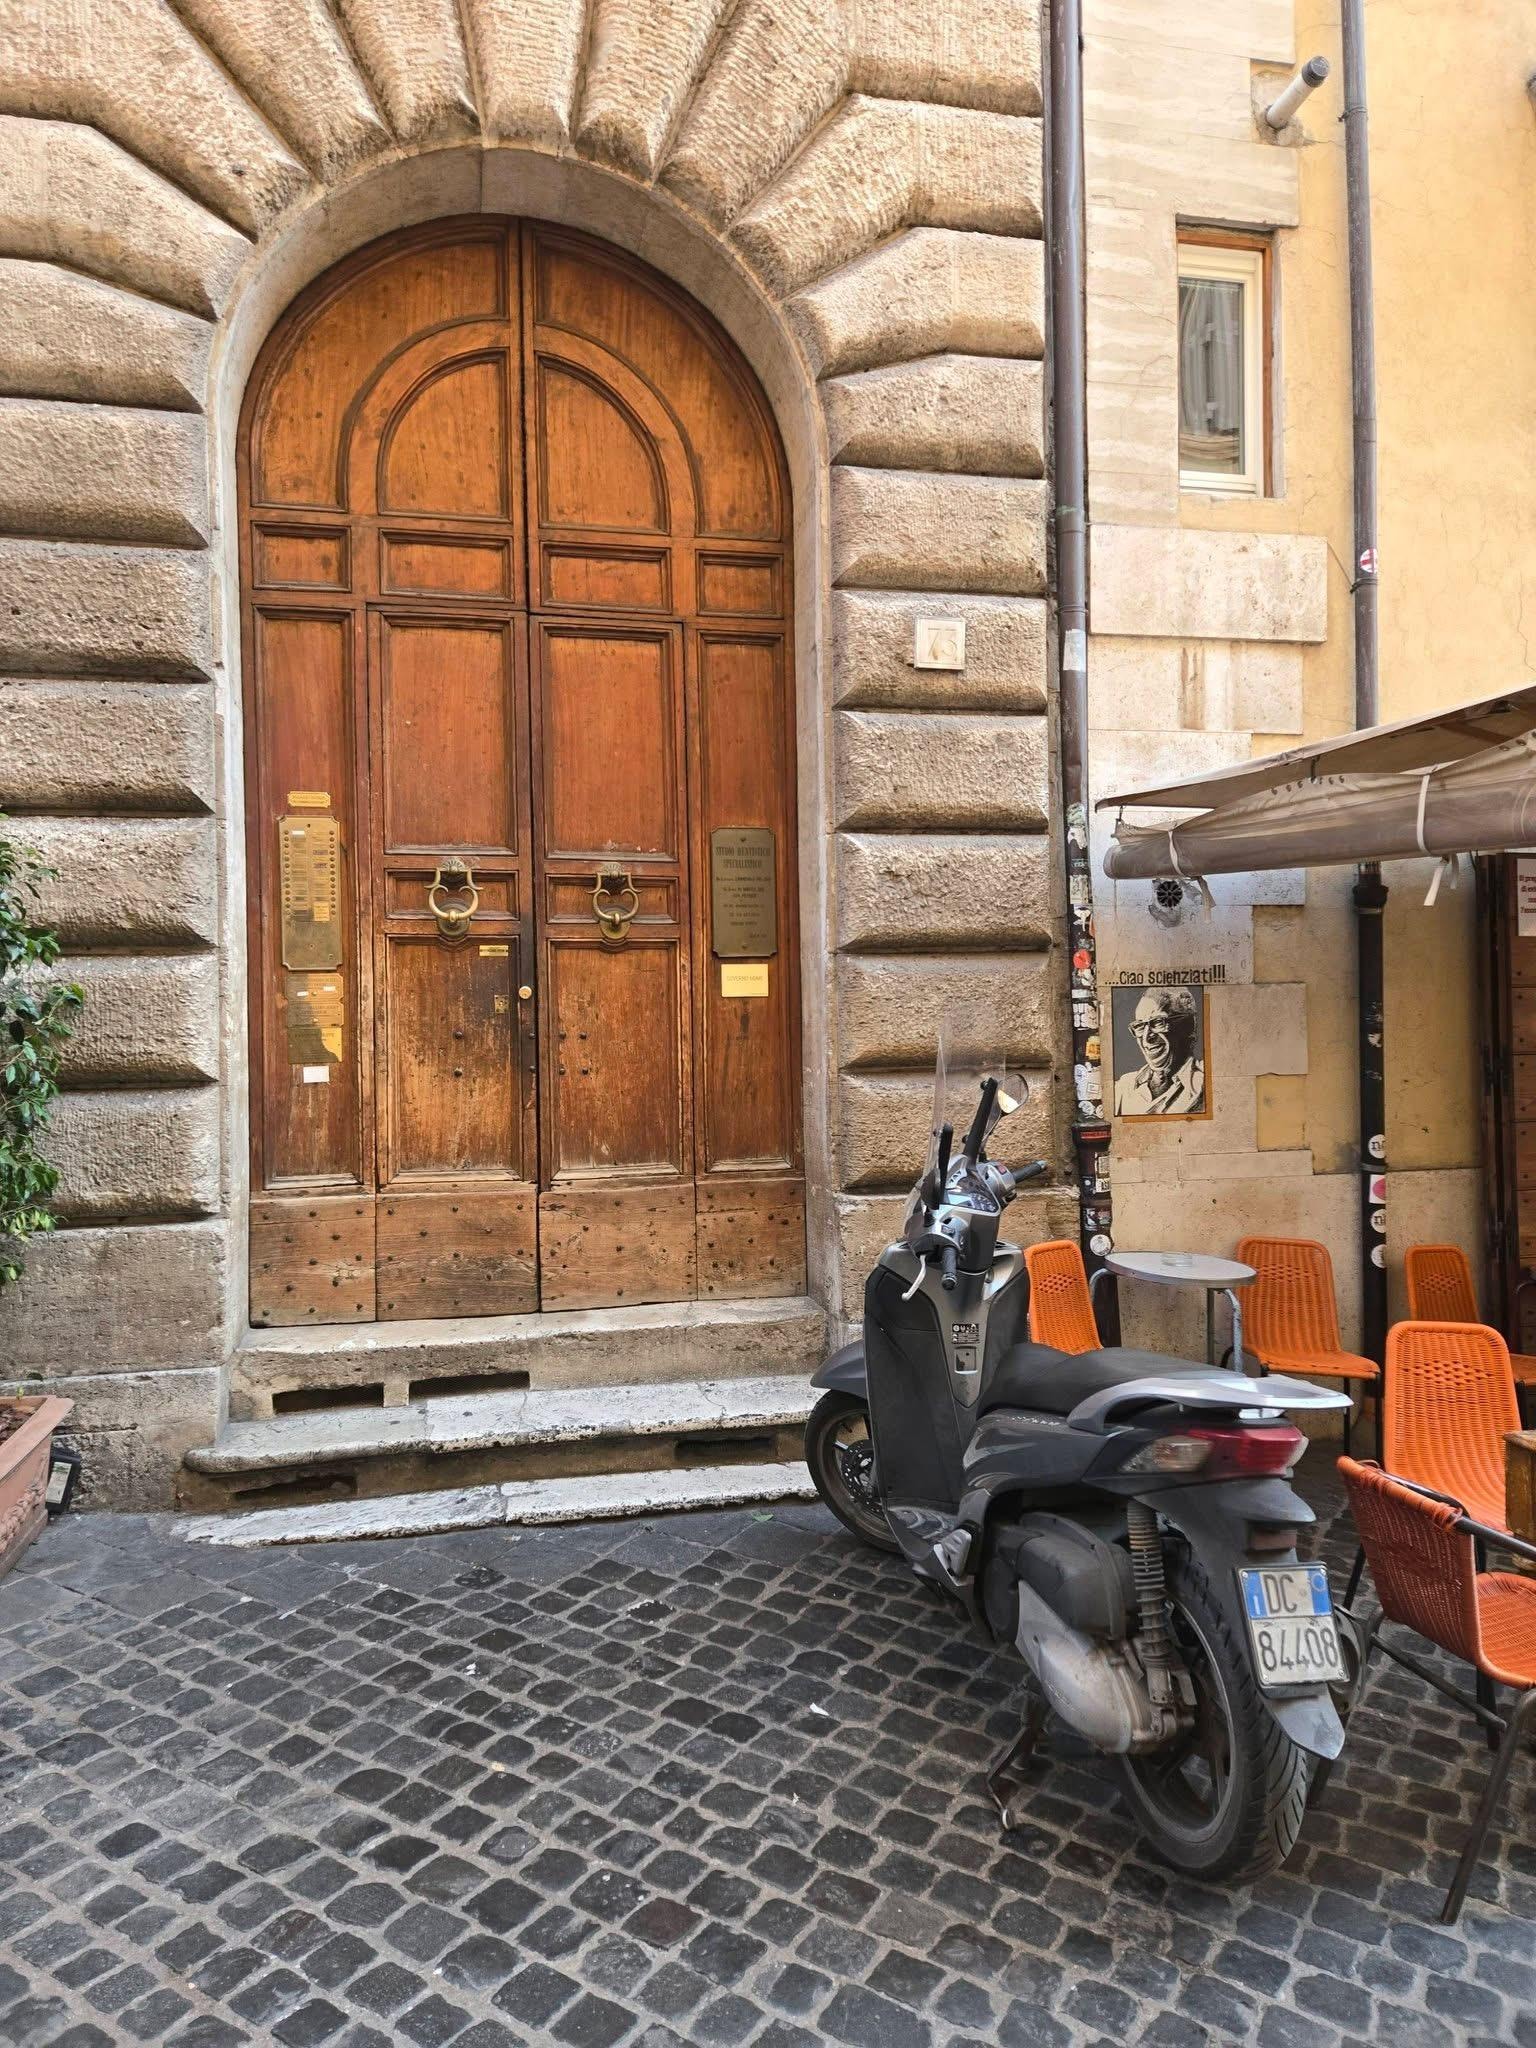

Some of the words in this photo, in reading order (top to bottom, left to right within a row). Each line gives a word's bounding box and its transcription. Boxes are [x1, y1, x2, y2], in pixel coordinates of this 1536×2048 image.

[1148, 965, 1226, 984] scienziati!!!
[1263, 1573, 1298, 1614] DC
[1258, 1627, 1339, 1672] 84408
